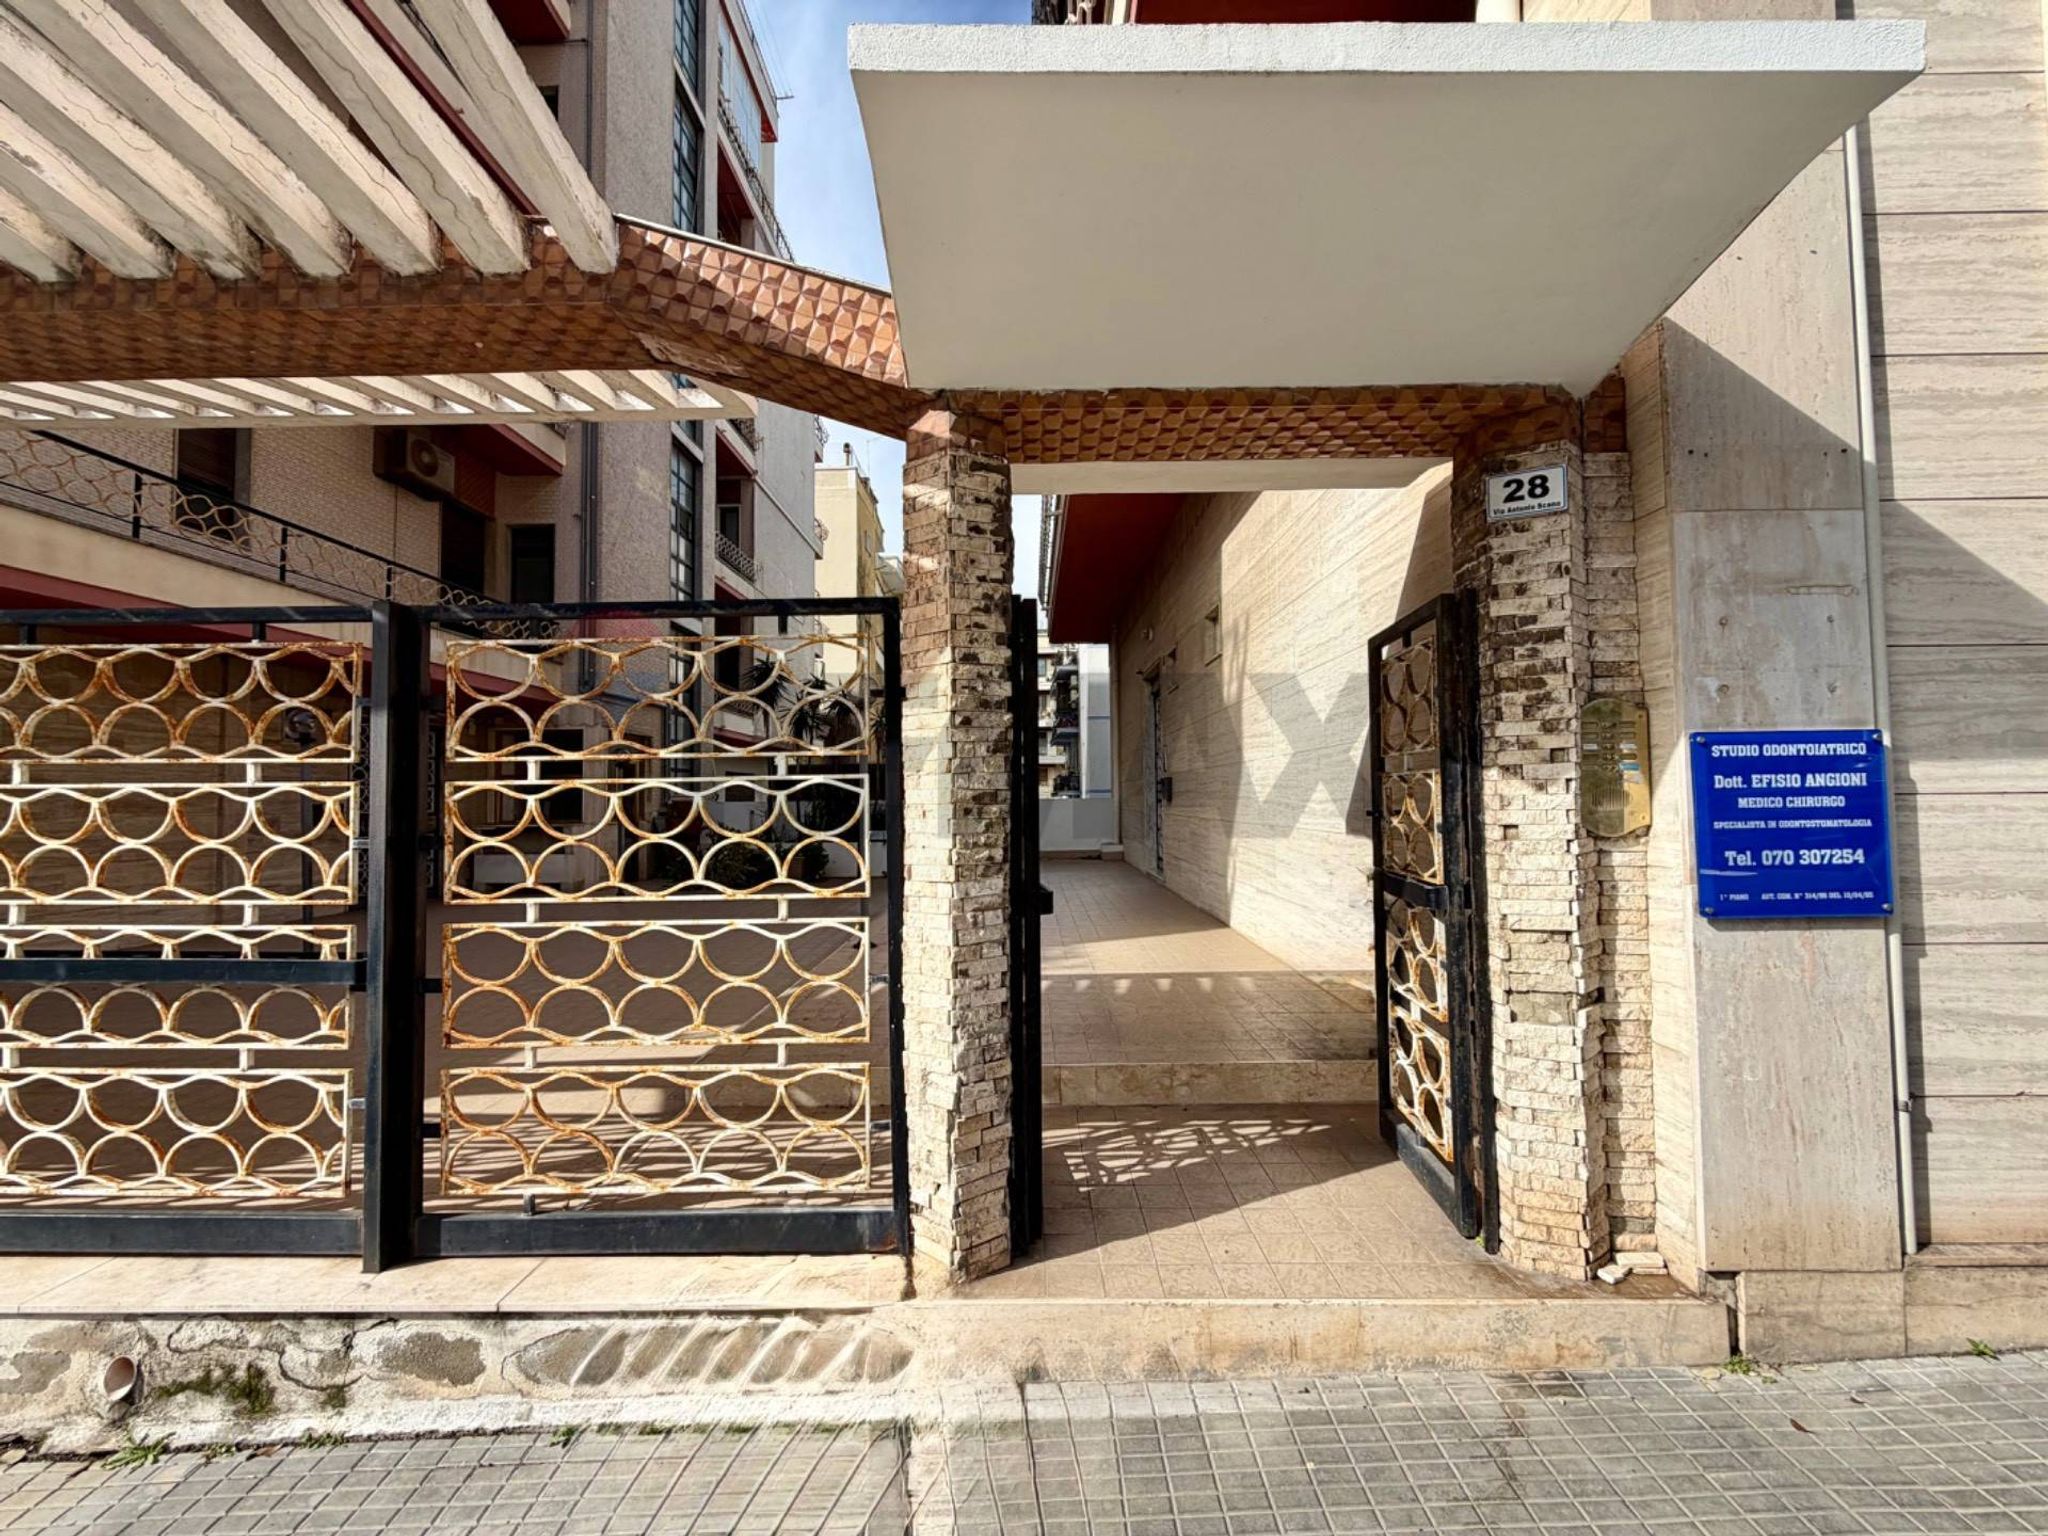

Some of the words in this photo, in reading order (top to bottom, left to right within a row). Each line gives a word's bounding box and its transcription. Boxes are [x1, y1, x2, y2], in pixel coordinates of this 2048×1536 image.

[1503, 474, 1550, 503] 28
[1711, 744, 1759, 757] STUDIO
[1763, 743, 1867, 756] ODONTOIATRICO
[1714, 774, 1748, 789] Dott.
[1751, 773, 1801, 788] EFISIO
[1805, 772, 1868, 787] ANGIONI
[1738, 797, 1783, 808] MEDICO
[1786, 796, 1846, 807] CHIRURGO
[1713, 820, 1766, 829] SPECIALISTA
[1767, 820, 1776, 829] IN
[1778, 819, 1872, 829] ODONTOSTOMATOLOGIA
[1725, 851, 1757, 866] Tel.
[1762, 850, 1795, 866] 070
[1799, 849, 1865, 865] 307254
